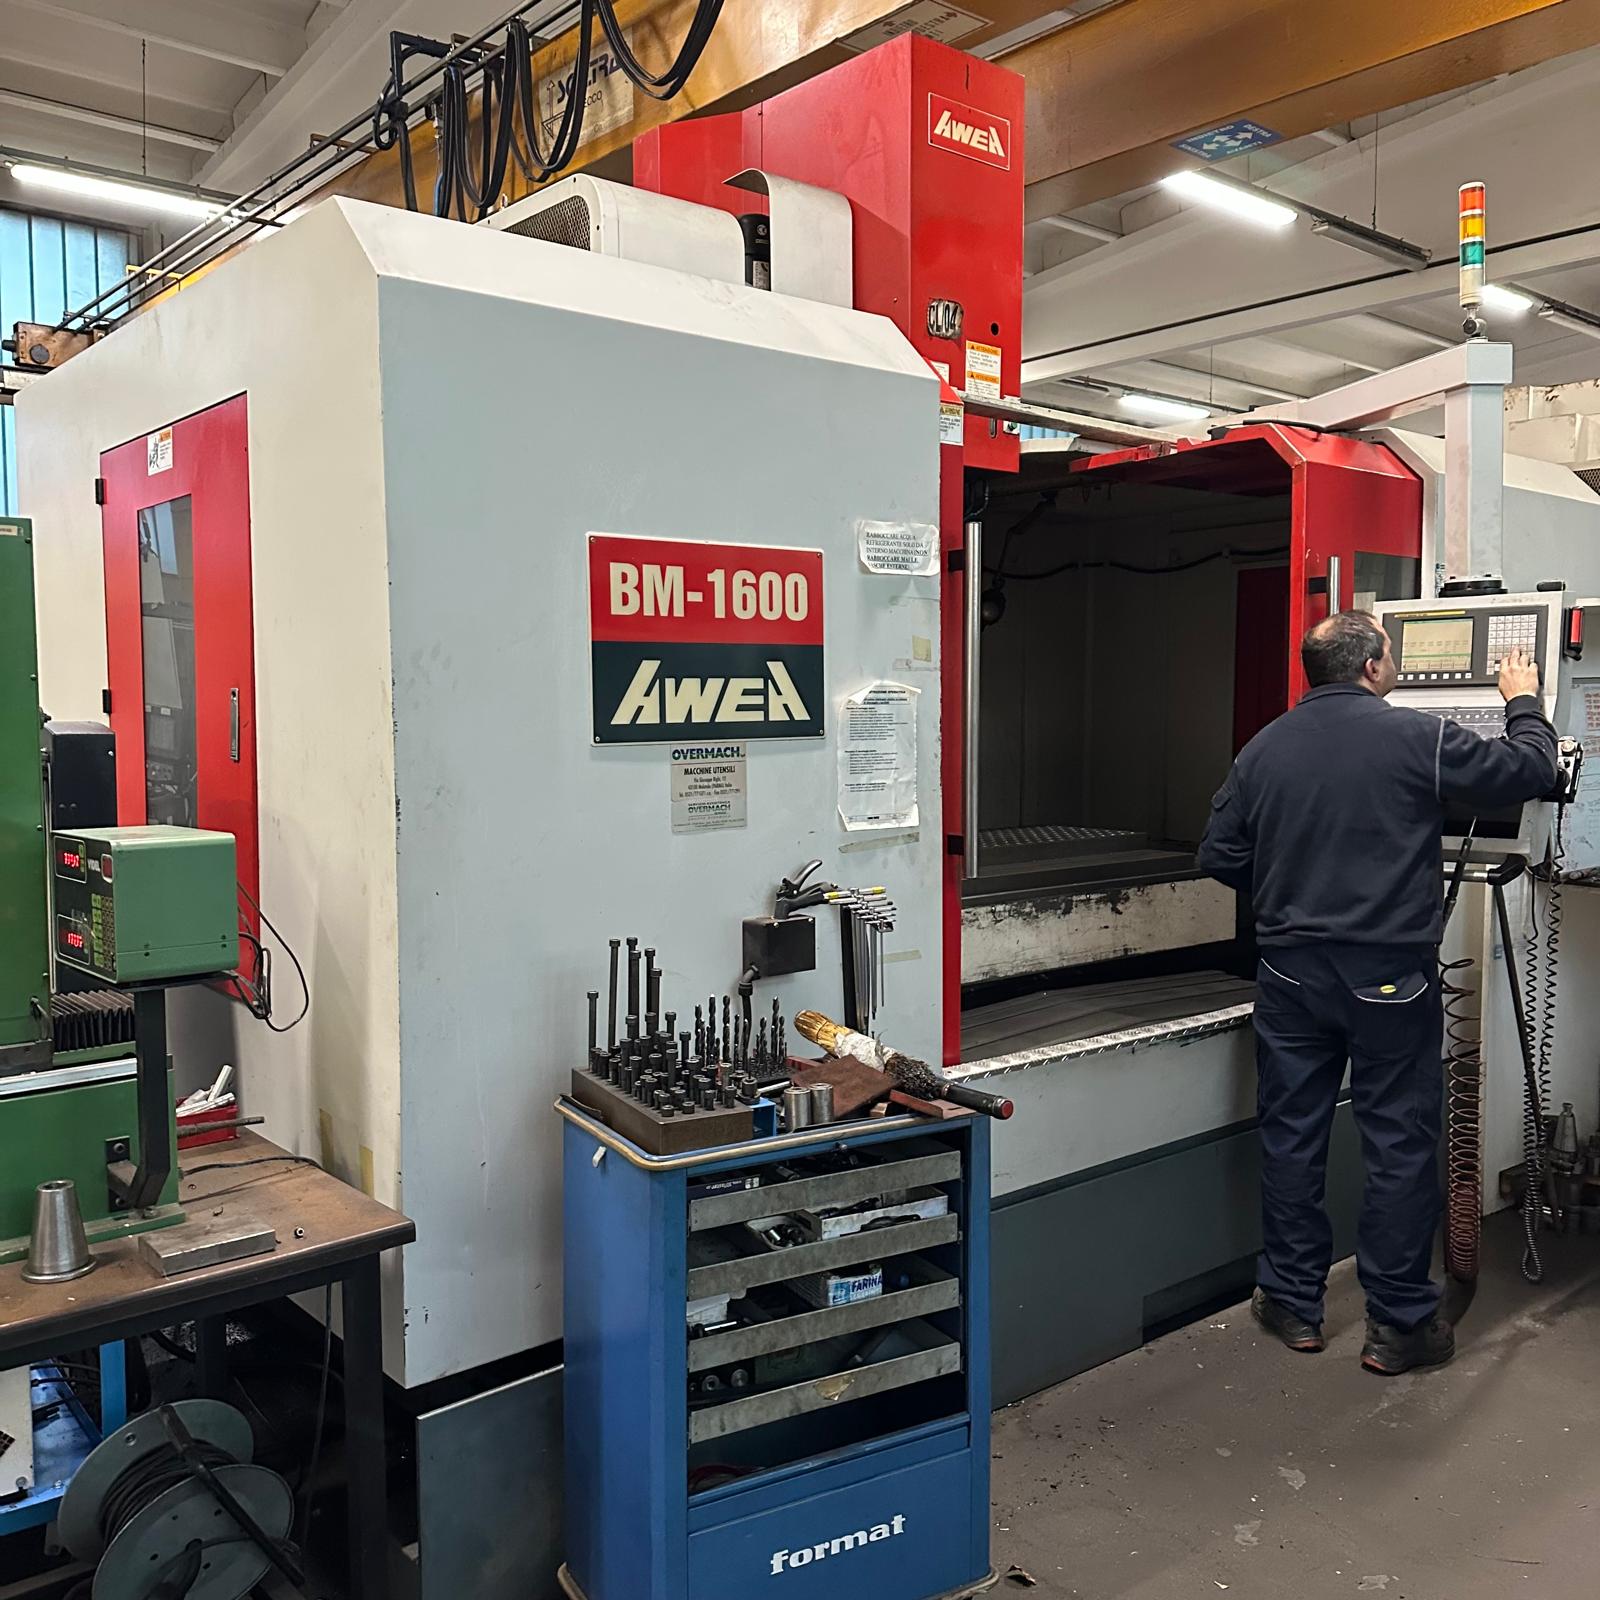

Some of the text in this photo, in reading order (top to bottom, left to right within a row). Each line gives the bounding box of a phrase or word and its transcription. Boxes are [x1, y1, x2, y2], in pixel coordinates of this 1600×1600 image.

[933, 110, 1006, 157] AWEA
[609, 561, 809, 622] BM-1600
[610, 660, 811, 725] AWEA
[672, 746, 740, 760] OVERMACH
[684, 766, 736, 775] MACCHINE UTENSILI
[688, 804, 731, 814] OVERMACH
[770, 1513, 906, 1576] format
